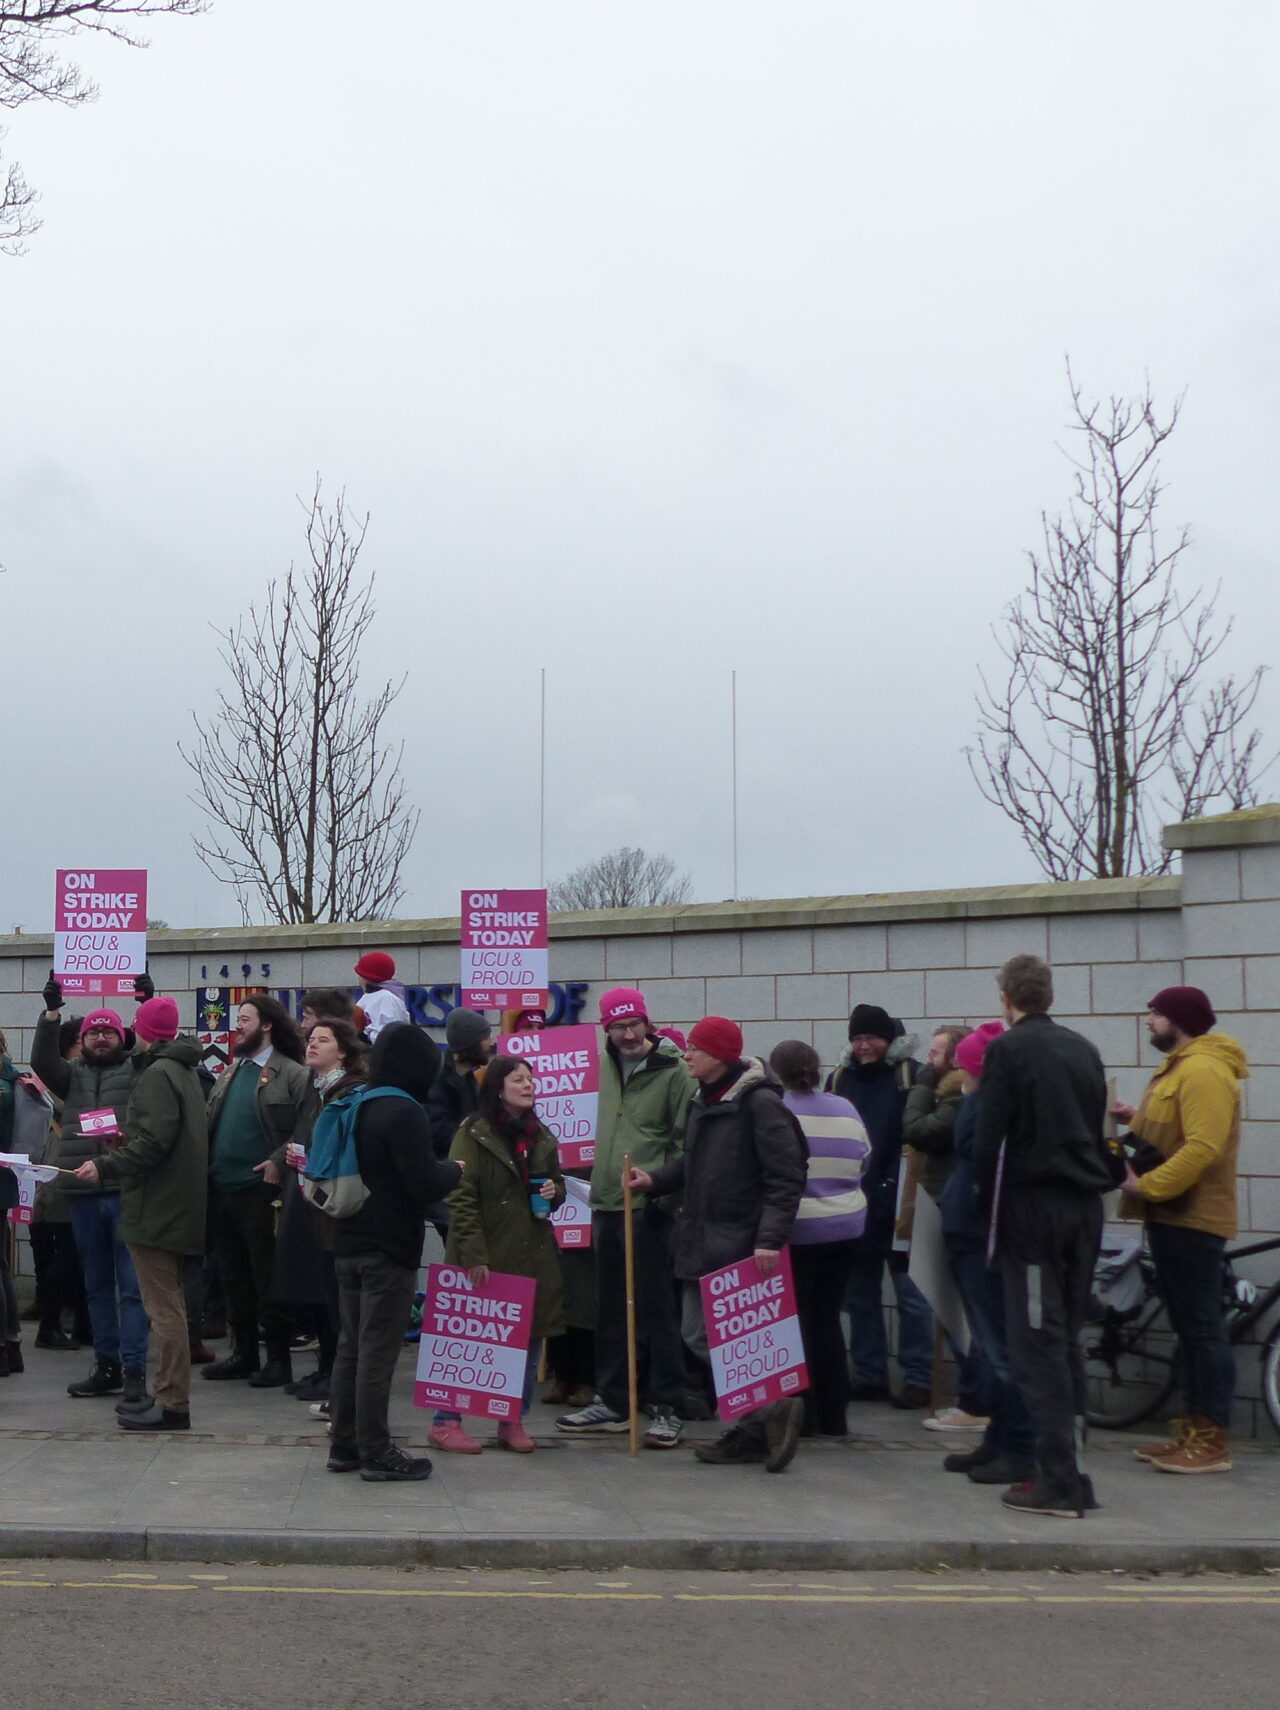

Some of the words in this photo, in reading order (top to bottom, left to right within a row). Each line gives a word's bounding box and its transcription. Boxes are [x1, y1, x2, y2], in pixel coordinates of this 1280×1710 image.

[64, 873, 95, 889] ON
[63, 892, 138, 909] STRIKE
[468, 893, 498, 909] ON
[63, 912, 133, 929] TODAY
[468, 912, 539, 927] STRIKE
[65, 935, 106, 951] UCU
[107, 935, 119, 951] &
[468, 930, 535, 946] TODAY
[63, 955, 132, 971] PROUD
[471, 951, 509, 967] UCU
[512, 952, 522, 967] &
[471, 970, 535, 986] PROUD
[506, 1034, 541, 1054] ON
[528, 1050, 590, 1073] TRIKE
[532, 1072, 586, 1095] ODAY
[534, 1101, 559, 1120] CU
[563, 1099, 575, 1117] &
[437, 1269, 472, 1291] ON
[709, 1268, 740, 1296] ON
[434, 1291, 522, 1322] STRIKE
[712, 1274, 785, 1319] STRIKE
[433, 1313, 515, 1343] TODAY
[714, 1298, 782, 1340] TODAY
[431, 1339, 480, 1362] UCU
[481, 1348, 494, 1366] &
[722, 1333, 760, 1365] UCU
[762, 1330, 775, 1349] &
[428, 1361, 507, 1390] PROUD
[725, 1347, 790, 1389] PROUD
